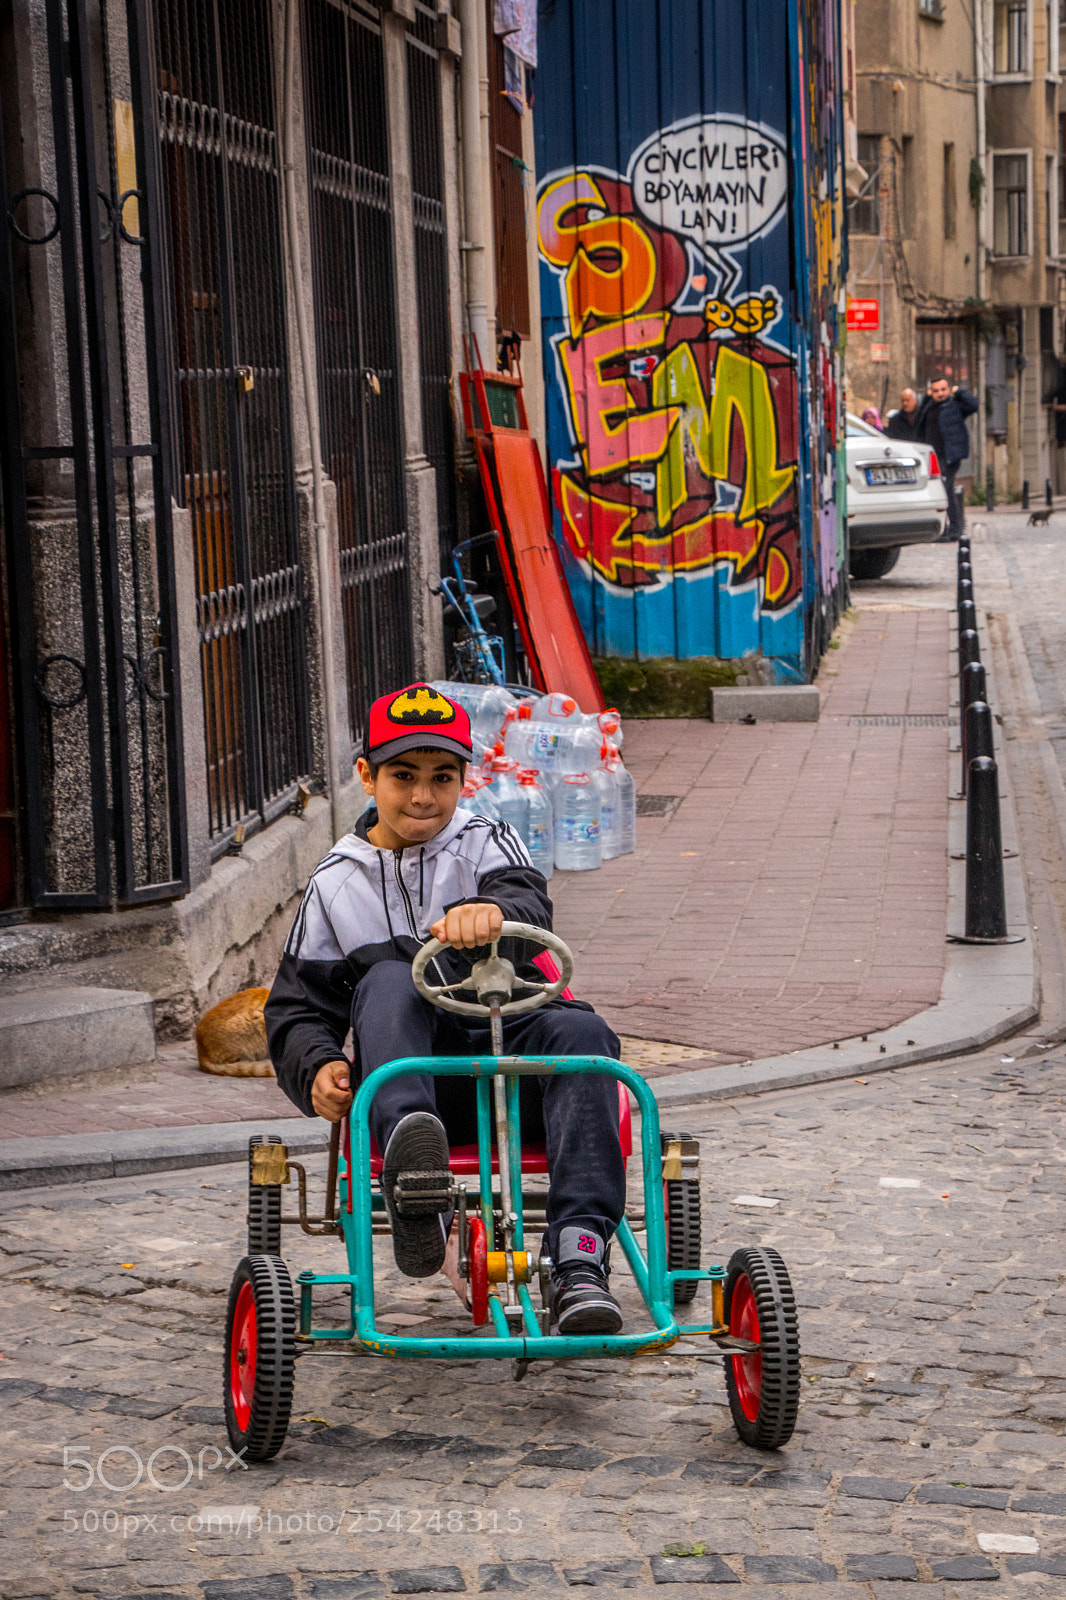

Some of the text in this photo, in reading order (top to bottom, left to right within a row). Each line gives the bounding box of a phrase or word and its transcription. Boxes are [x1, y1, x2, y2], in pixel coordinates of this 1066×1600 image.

[643, 175, 767, 208] BOYAMAYIN
[680, 208, 738, 235] LAN!
[577, 1234, 597, 1255] 23
